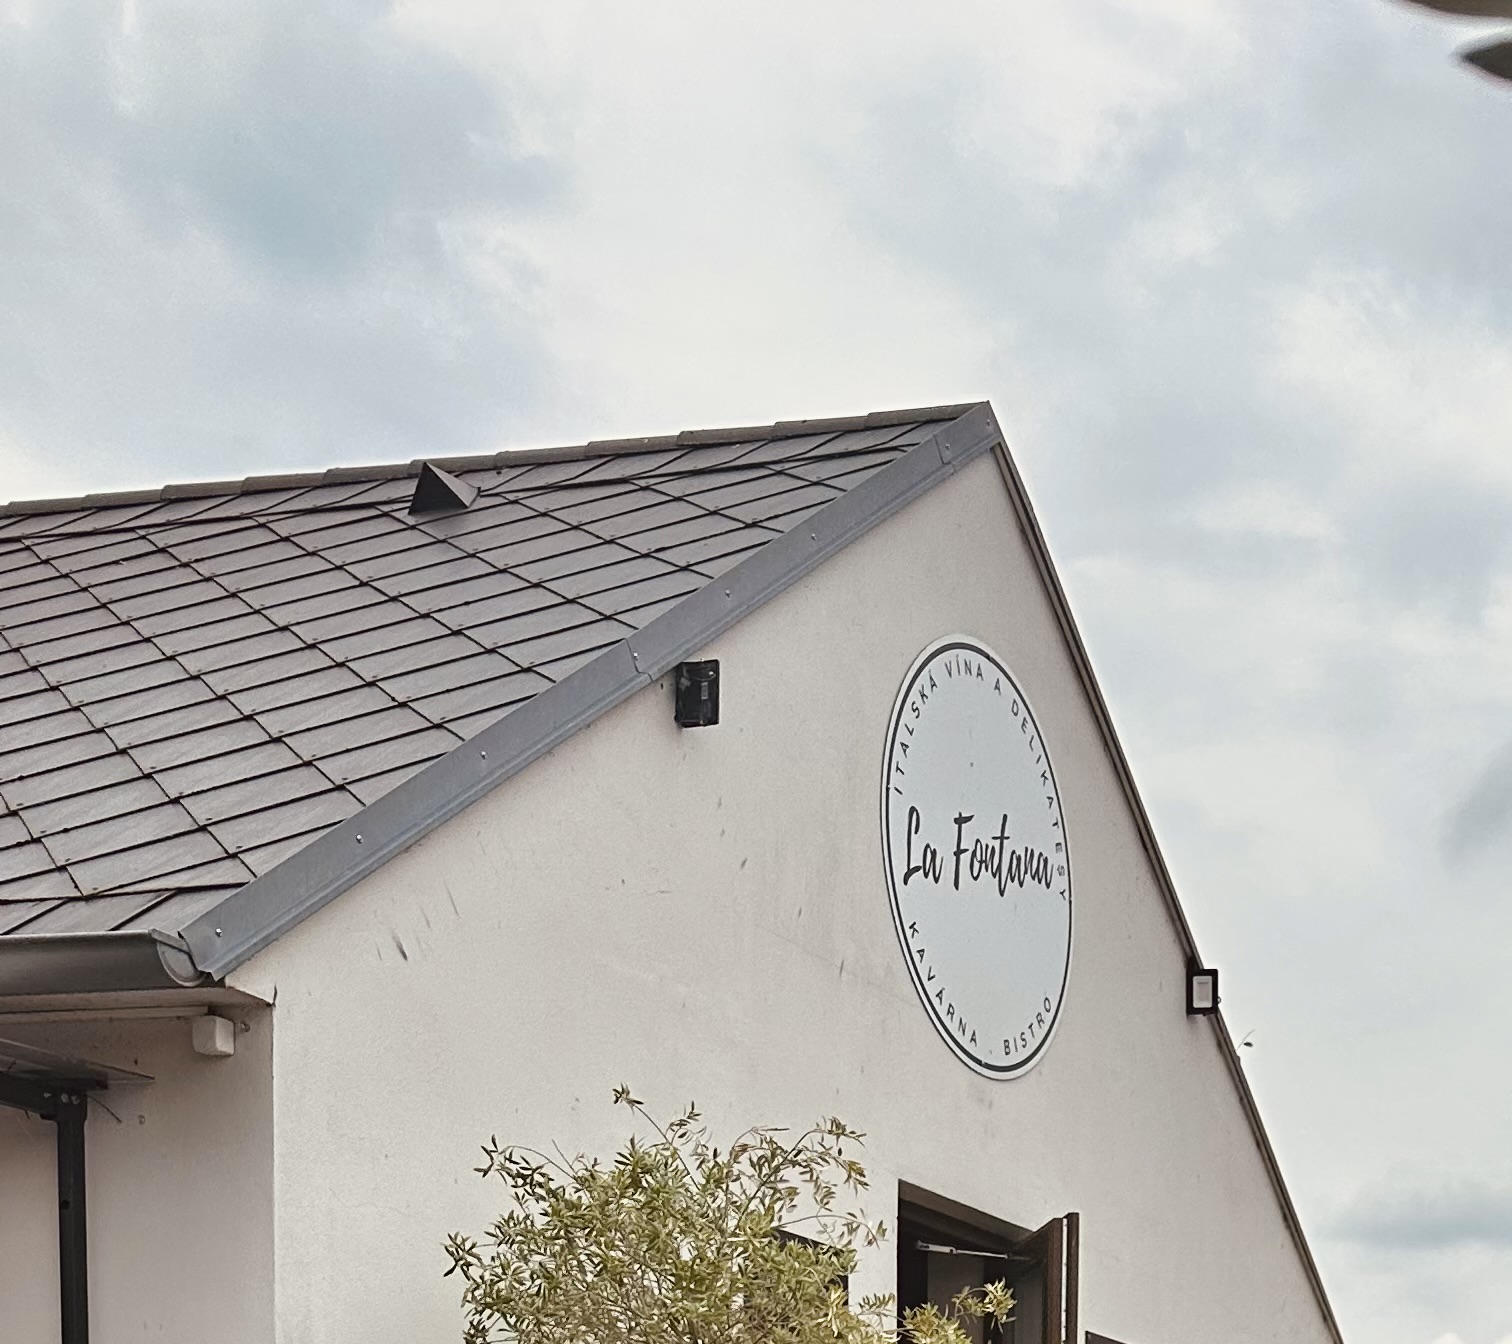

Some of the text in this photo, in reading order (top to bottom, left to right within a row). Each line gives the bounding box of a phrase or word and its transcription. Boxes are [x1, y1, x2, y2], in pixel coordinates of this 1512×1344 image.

[894, 654, 1067, 901] ITALSKÁ VÍNA A DELIKATESY
[903, 806, 1055, 897] La Fontana
[909, 921, 1052, 1056] KAVÁRNA BISTRO
